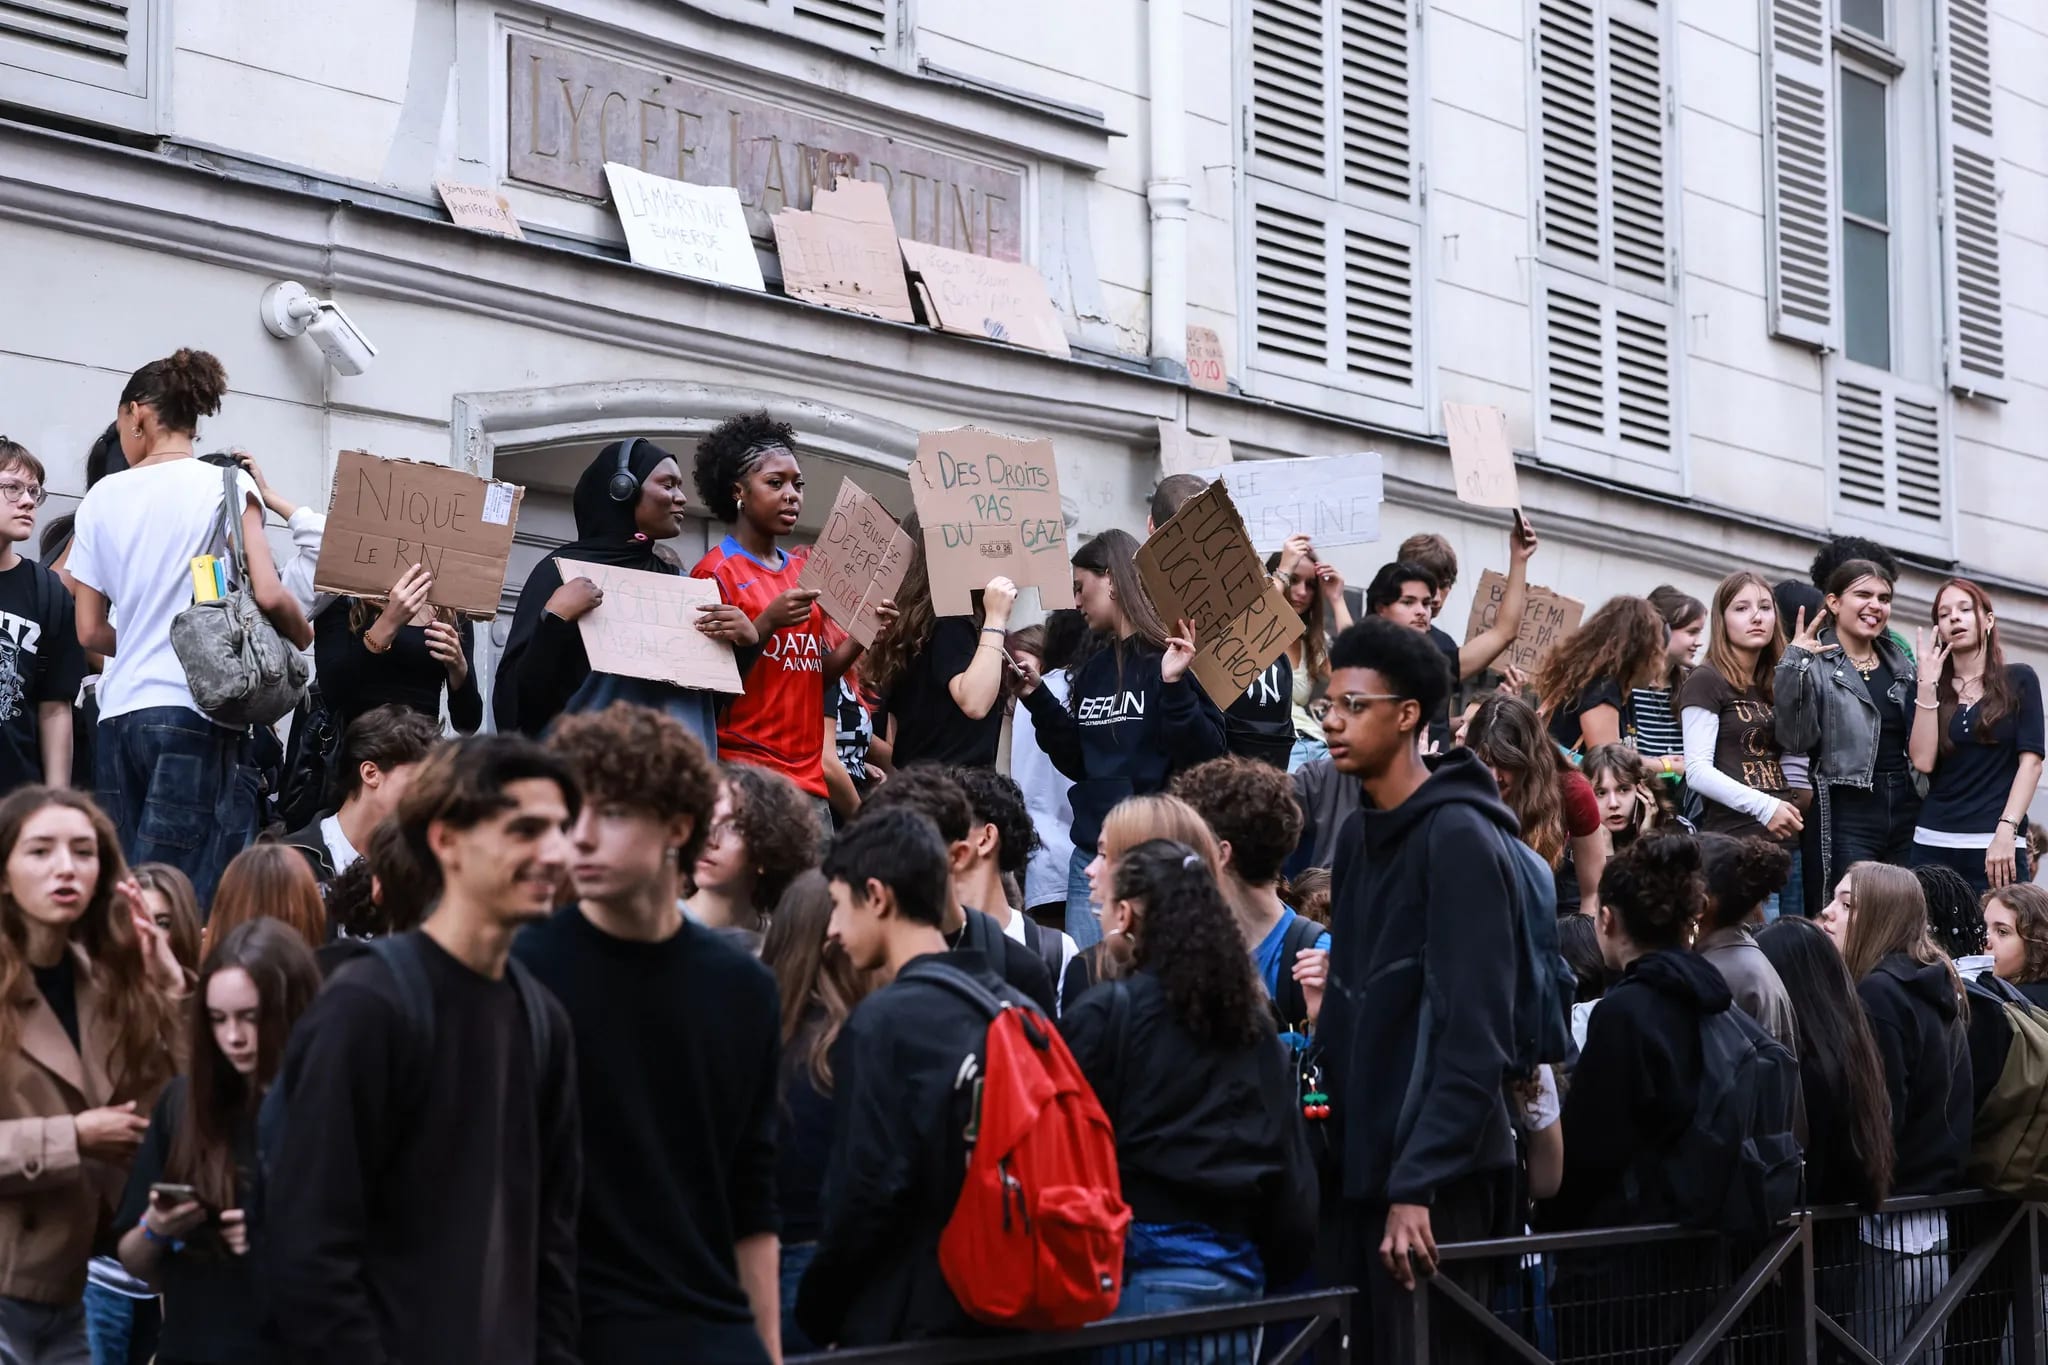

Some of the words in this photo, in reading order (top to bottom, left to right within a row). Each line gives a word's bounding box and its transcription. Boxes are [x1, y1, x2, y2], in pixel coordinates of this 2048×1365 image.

[937, 451, 981, 489] DES
[840, 487, 857, 514] LA
[858, 506, 902, 564] JEUNESSE
[968, 494, 1013, 521] PAS
[942, 521, 973, 548] DU
[1020, 519, 1065, 548] GAZ!
[354, 536, 378, 565] LE
[394, 538, 444, 581] RN
[812, 549, 832, 582] EN
[1181, 491, 1242, 570] FUCK
[1220, 554, 1255, 608] LE
[1244, 595, 1287, 654] RN
[1149, 521, 1207, 600] FUCK
[1200, 612, 1263, 690] FACHOS
[1078, 690, 1145, 719] BERLIN
